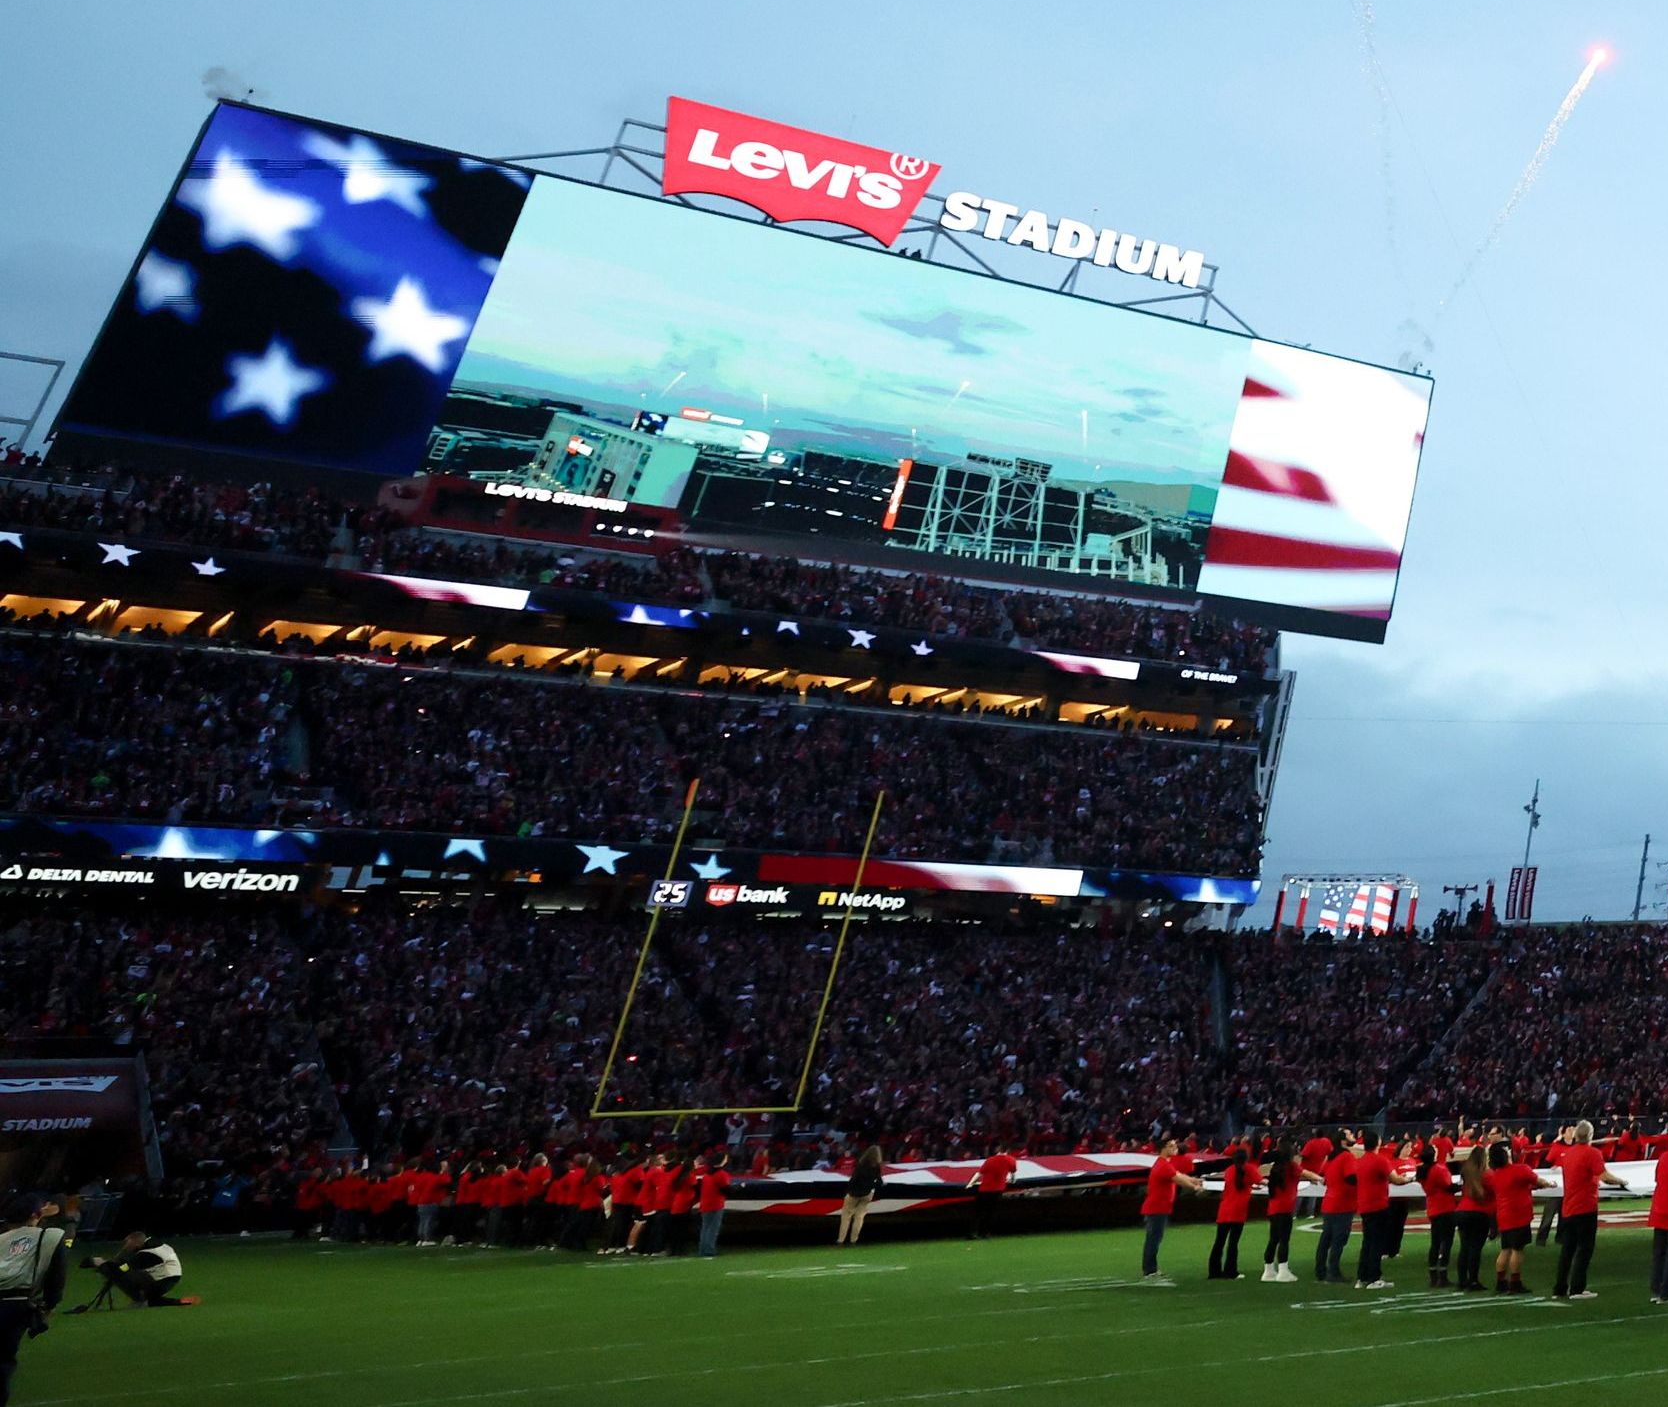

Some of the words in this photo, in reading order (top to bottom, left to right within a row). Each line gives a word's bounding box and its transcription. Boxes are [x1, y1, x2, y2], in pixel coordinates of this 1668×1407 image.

[938, 191, 1204, 290] STADIUM
[27, 868, 82, 881] DELTA
[85, 869, 154, 883] DENTAL
[184, 868, 299, 891] verizon
[736, 885, 790, 904] bank
[838, 893, 906, 910] NetApp
[1, 1116, 94, 1132] STADIUM
